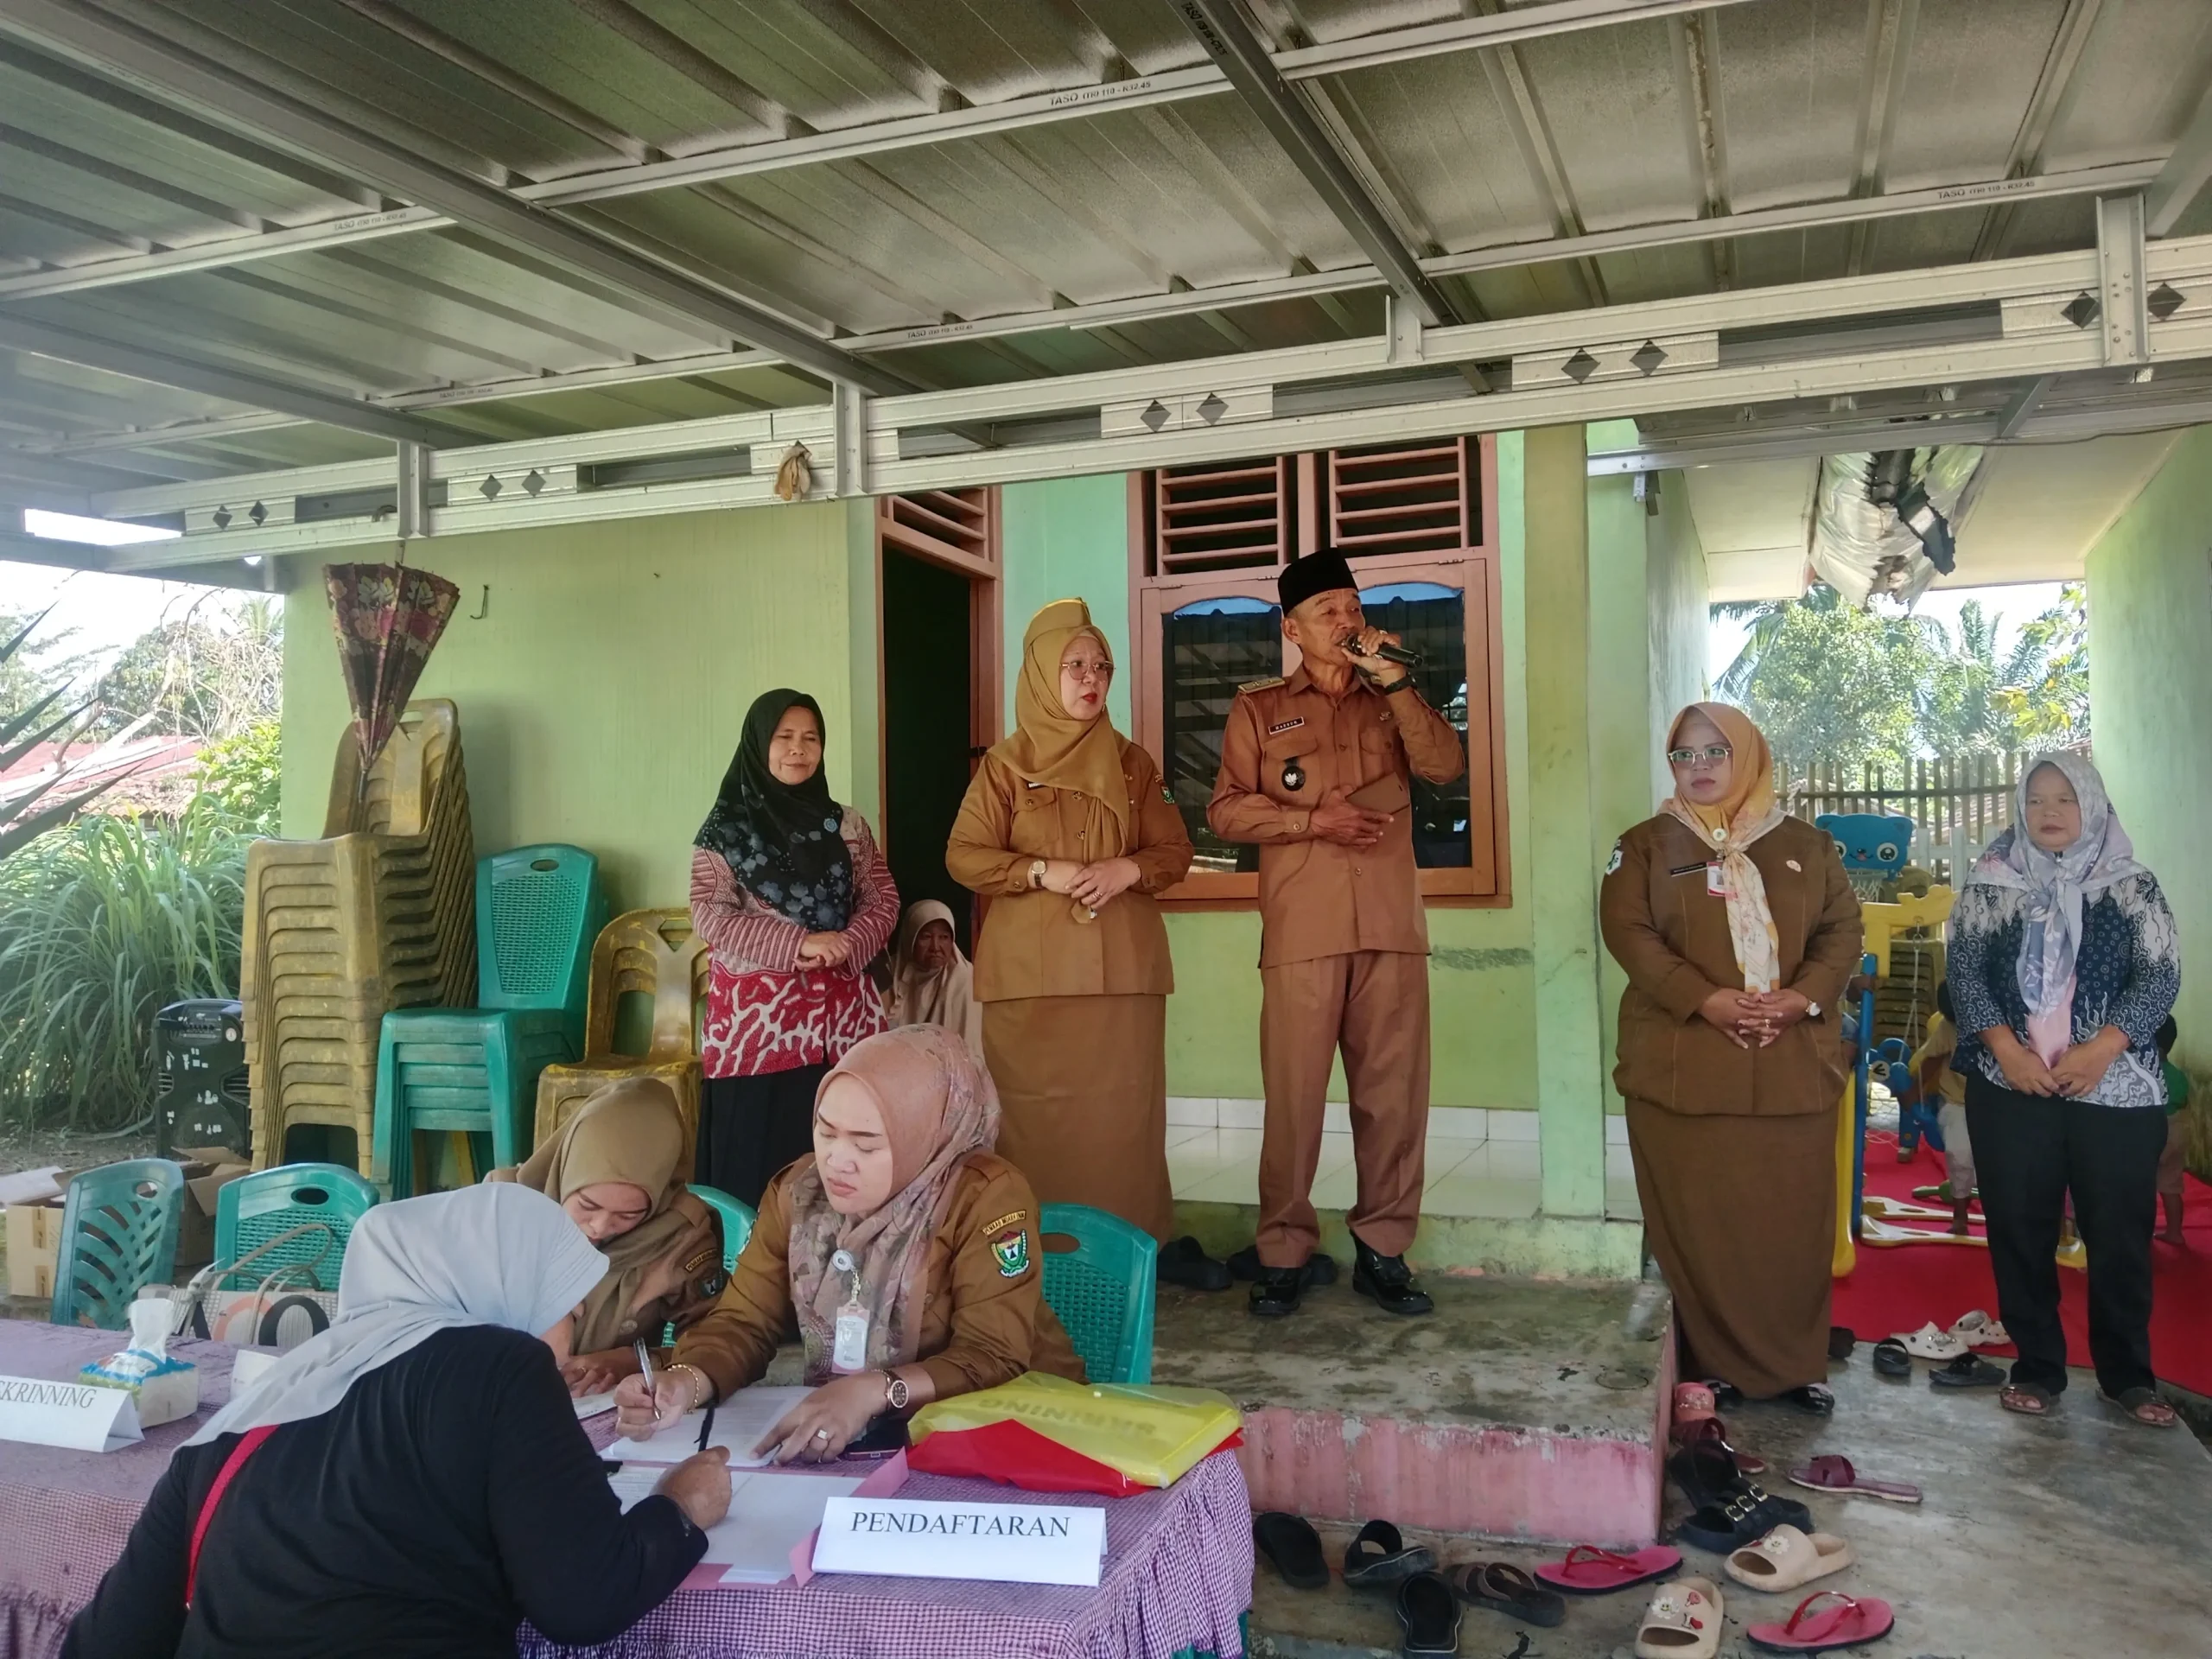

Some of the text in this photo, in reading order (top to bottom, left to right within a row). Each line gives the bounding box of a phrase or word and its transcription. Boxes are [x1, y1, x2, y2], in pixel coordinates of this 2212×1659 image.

[1050, 92, 1078, 105] TASO
[1102, 87, 1116, 96] 110
[1936, 188, 1966, 200] TASO
[907, 329, 926, 339] TASO
[849, 1511, 1071, 1538] PENDAFTARAN
